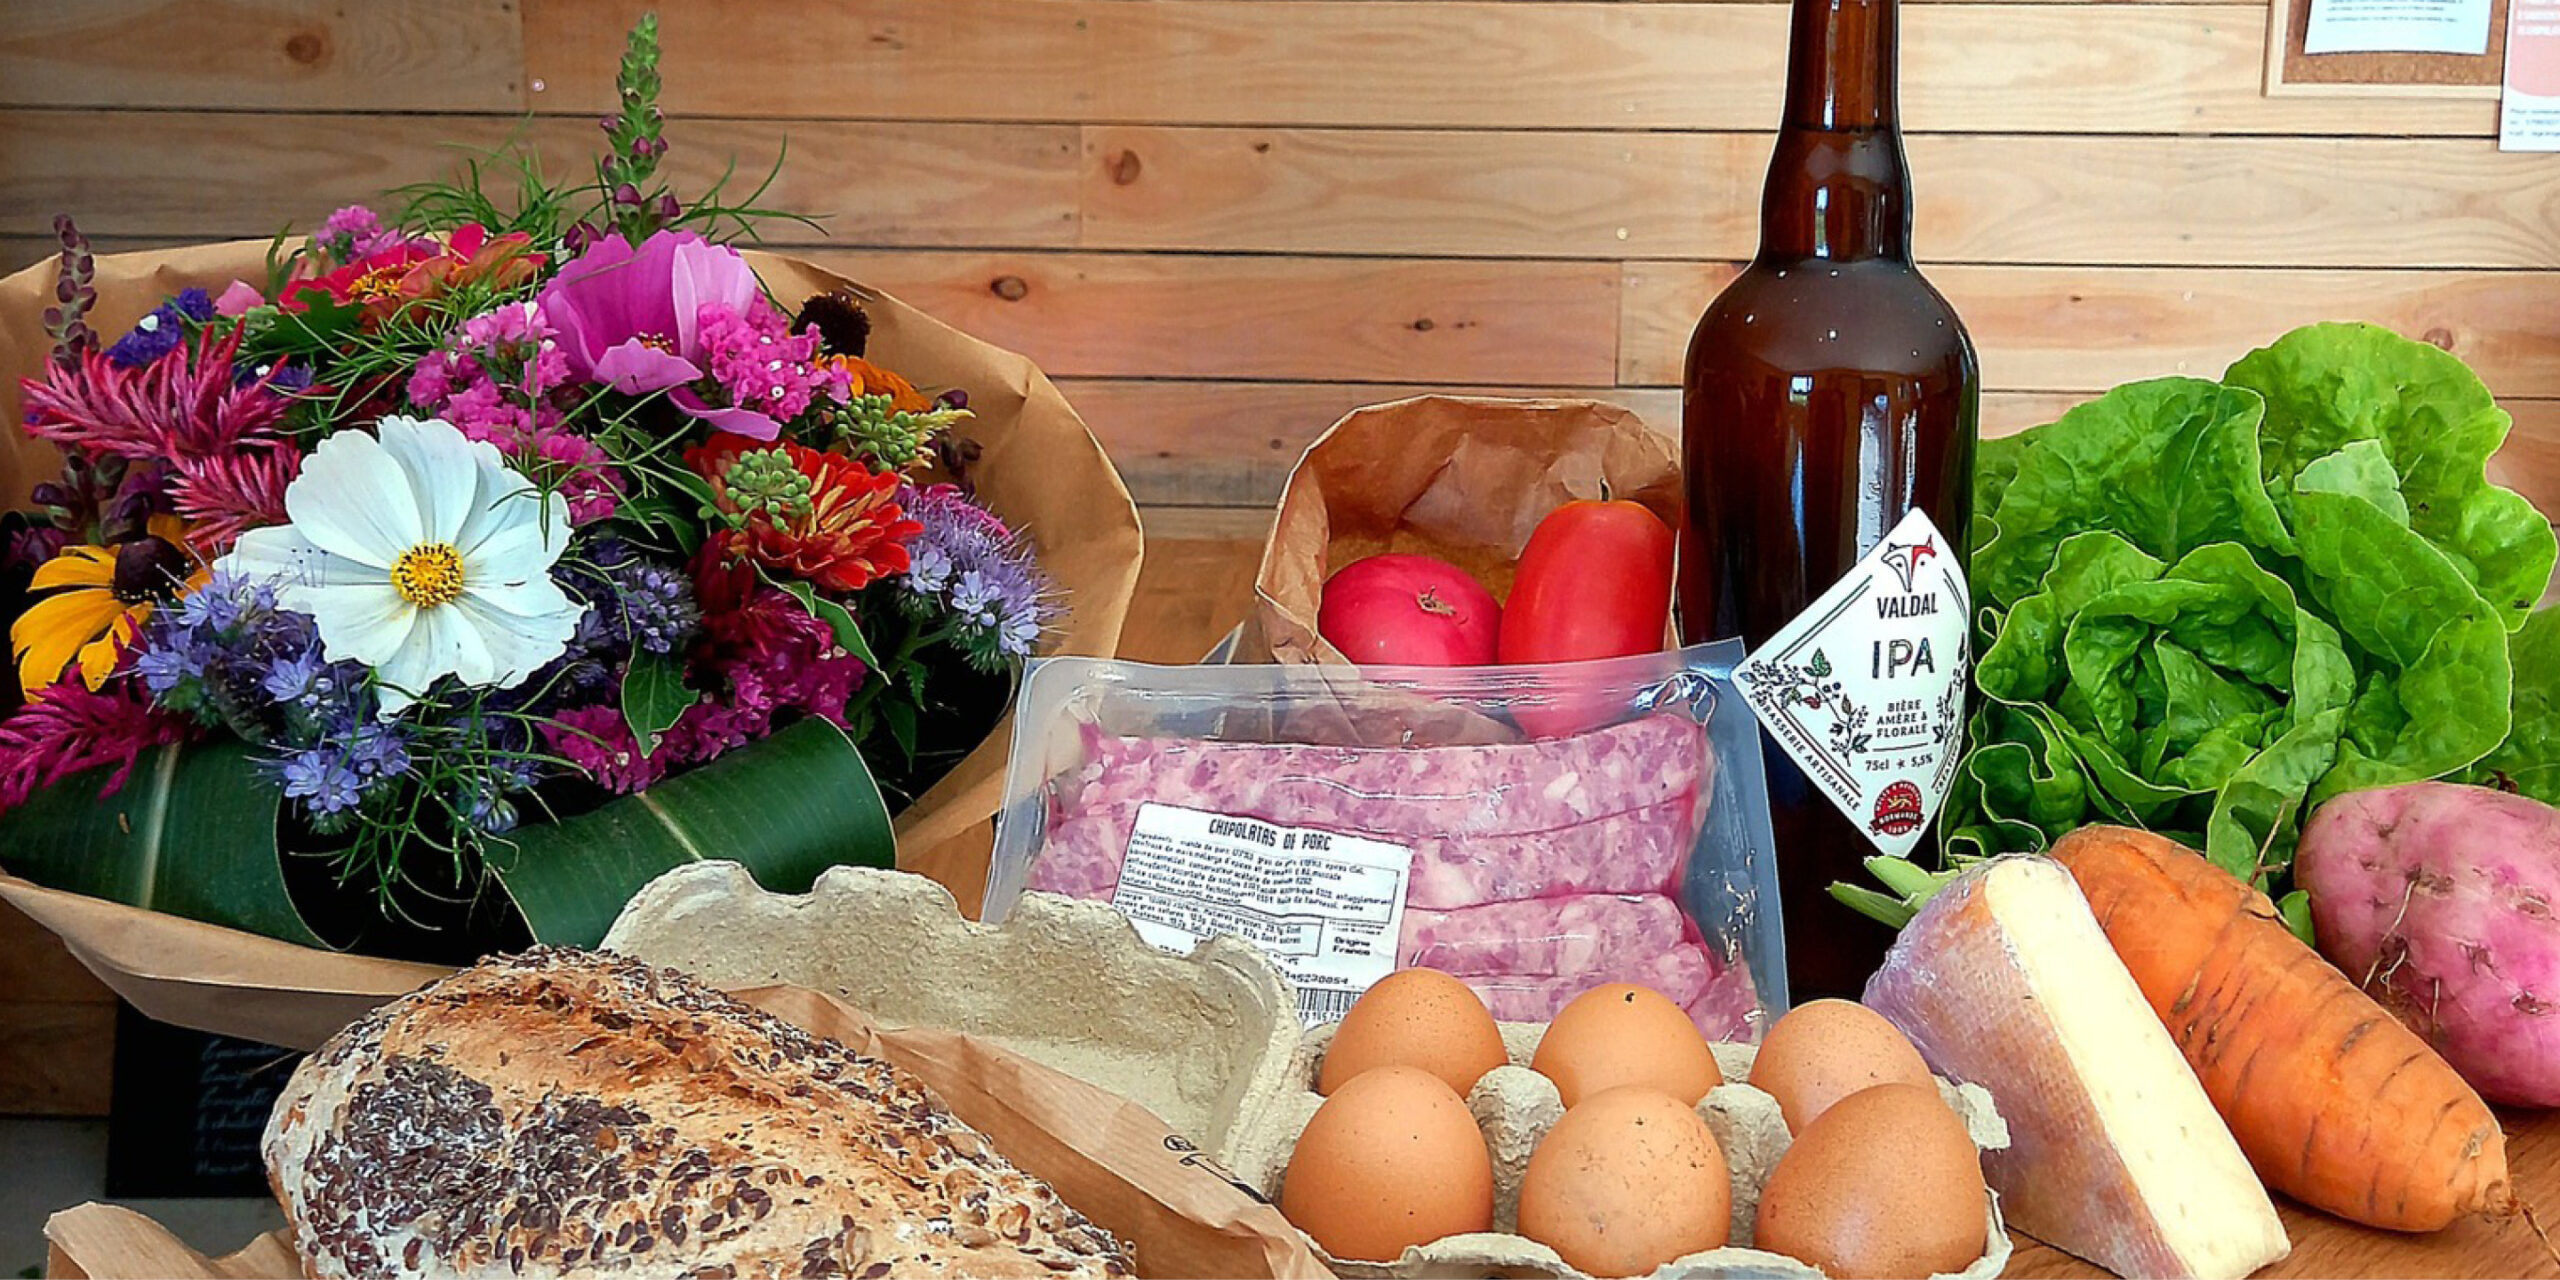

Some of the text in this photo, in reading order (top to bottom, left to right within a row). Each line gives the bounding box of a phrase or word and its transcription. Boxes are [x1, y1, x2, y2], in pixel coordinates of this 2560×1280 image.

[1877, 592, 1938, 620] VALDAL
[1872, 637, 1936, 680] IPA
[1887, 698, 1922, 713] BIÈRE
[1876, 712, 1917, 726] AMÈRE
[1876, 723, 1928, 739] FLORALE
[1865, 753, 1934, 772] 75cl 5,5%
[1804, 754, 1862, 812] ARTISANALE
[1208, 818, 1277, 847] CHIPOLATAS
[1301, 832, 1332, 851] PORC
[1333, 935, 1371, 947] Origine
[1332, 944, 1371, 956] France
